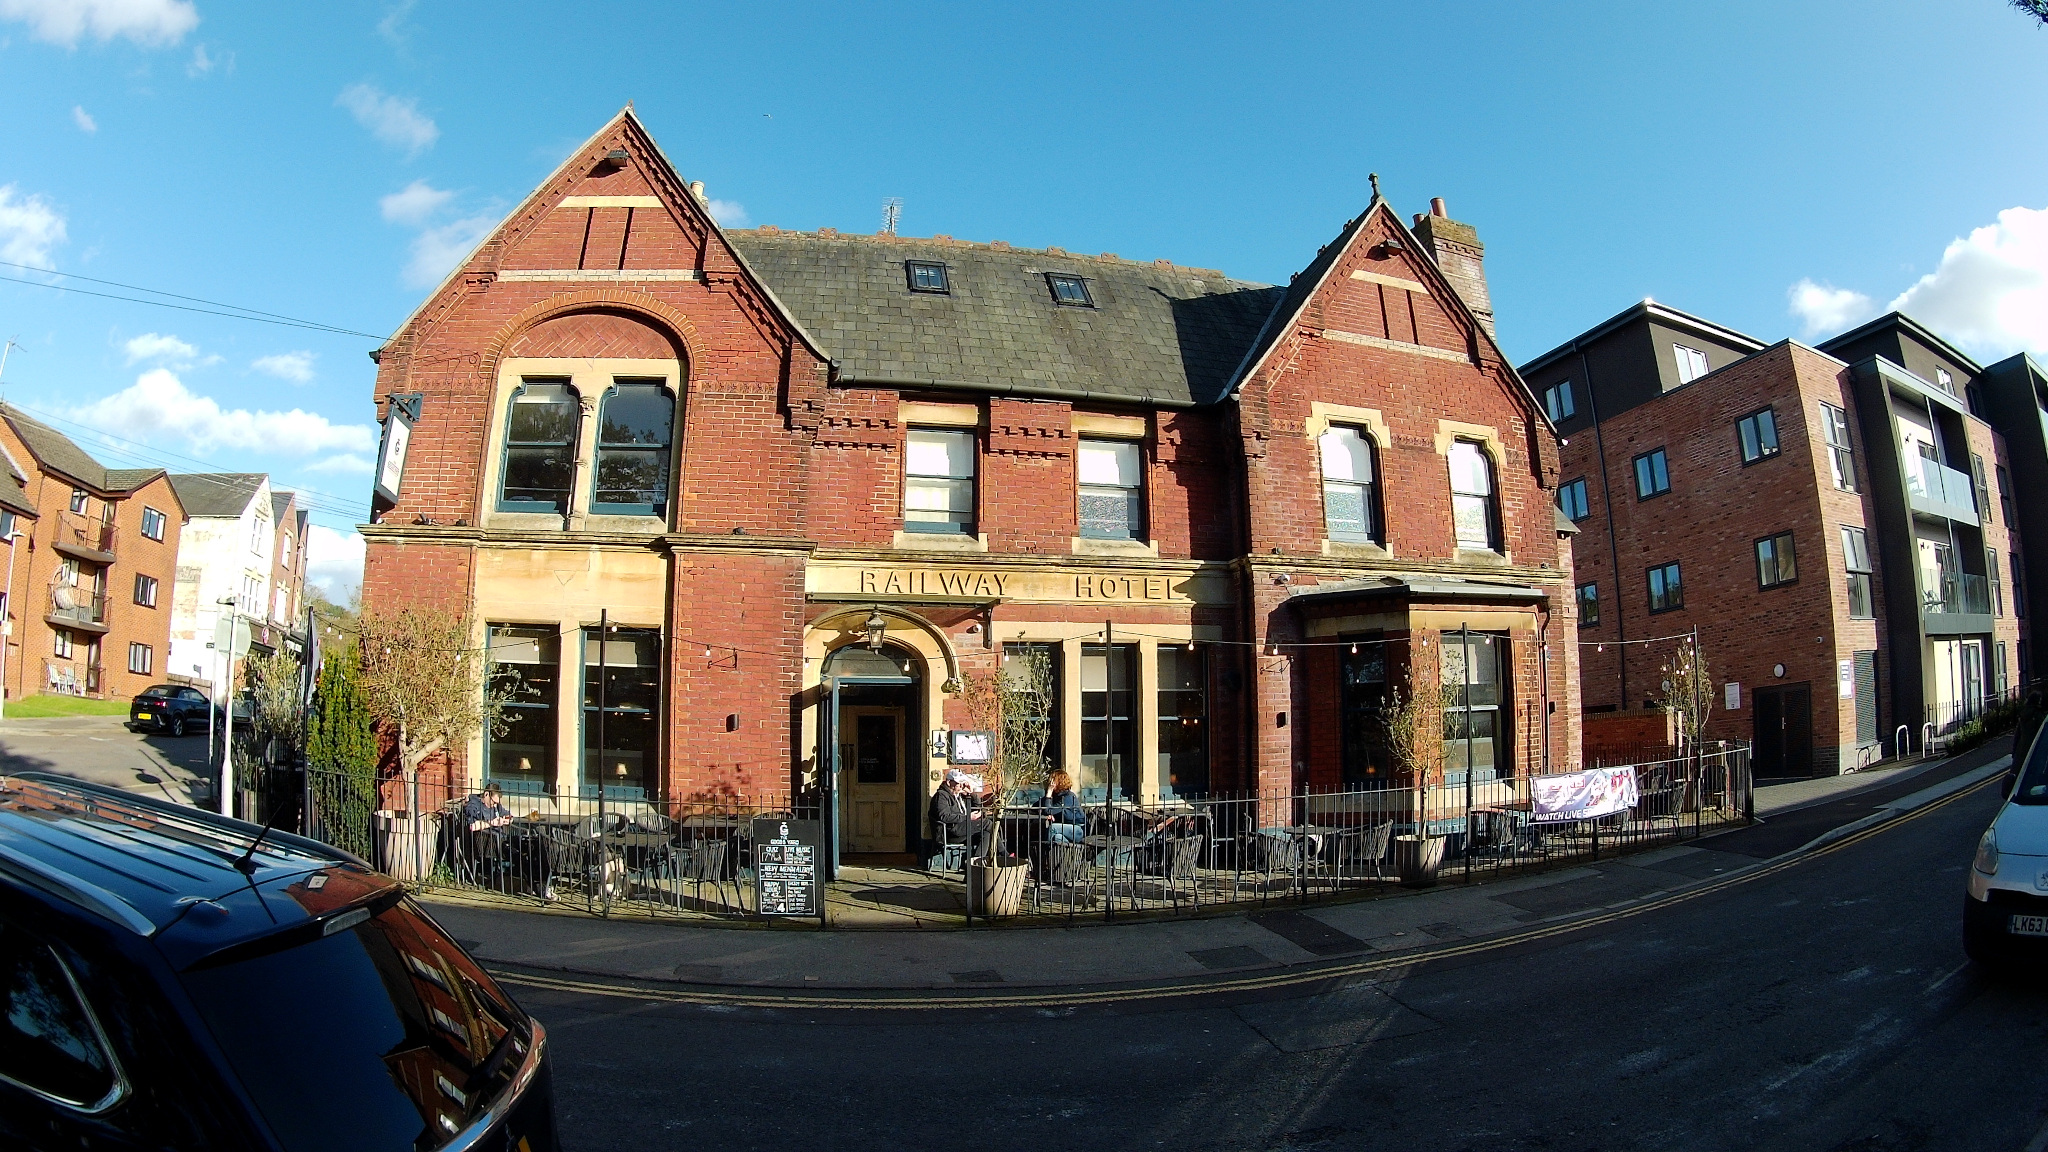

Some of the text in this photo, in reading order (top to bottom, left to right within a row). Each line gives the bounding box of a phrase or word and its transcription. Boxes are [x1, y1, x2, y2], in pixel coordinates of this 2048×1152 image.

[860, 571, 1185, 600] RAILWAY HOTEL
[1535, 811, 1564, 821] WATCH
[1564, 809, 1582, 819] LIVE
[2014, 916, 2043, 932] LK63
